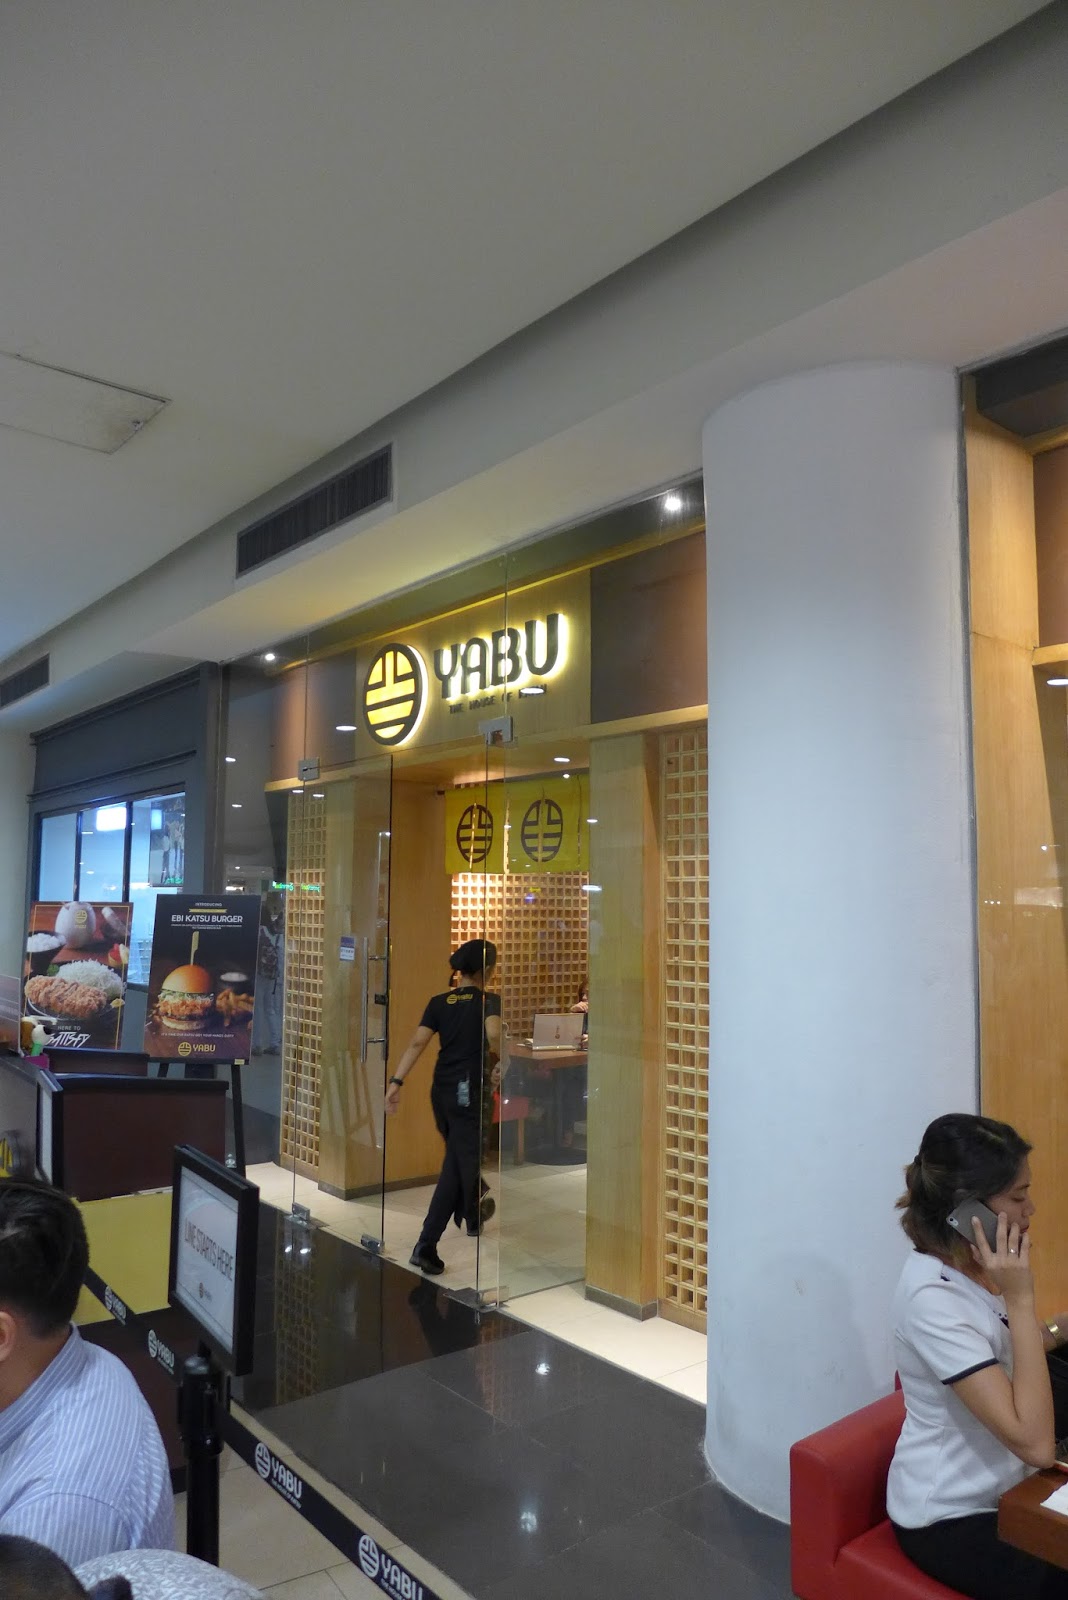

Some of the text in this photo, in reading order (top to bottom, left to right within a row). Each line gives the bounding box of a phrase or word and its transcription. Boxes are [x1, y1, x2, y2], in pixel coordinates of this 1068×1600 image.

[433, 612, 560, 699] YABU
[171, 914, 243, 923] EBI KATSU BURGER
[193, 1044, 216, 1052] YABU
[216, 1245, 234, 1282] HERE
[271, 1456, 302, 1499] YABU
[381, 1553, 423, 1600] YABU
